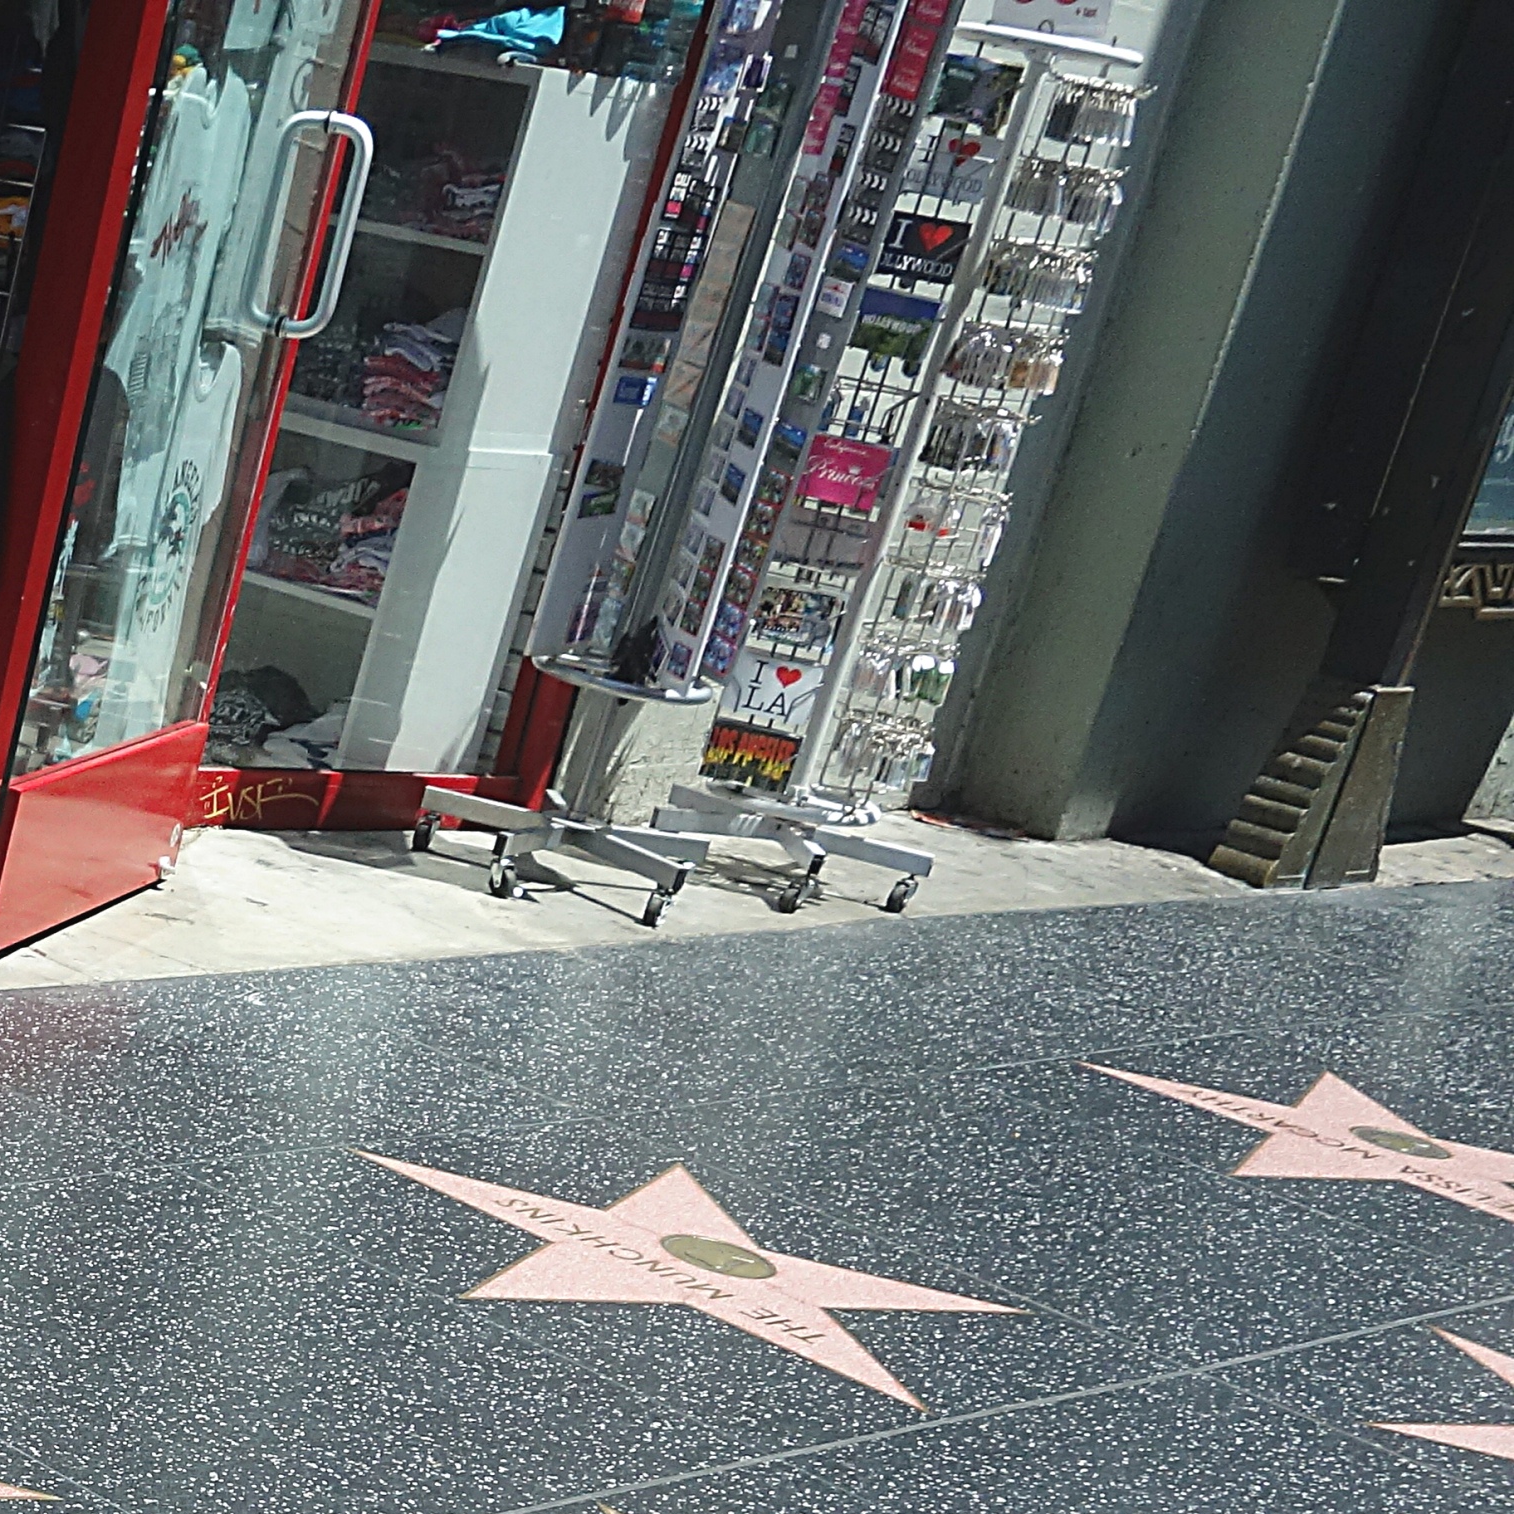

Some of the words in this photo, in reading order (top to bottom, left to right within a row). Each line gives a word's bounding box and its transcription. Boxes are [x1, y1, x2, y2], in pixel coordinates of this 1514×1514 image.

[889, 219, 913, 249] I
[750, 660, 769, 684] I
[741, 685, 788, 717] LA
[494, 1197, 736, 1301] MUNCHKINS
[738, 1306, 827, 1346] THE
